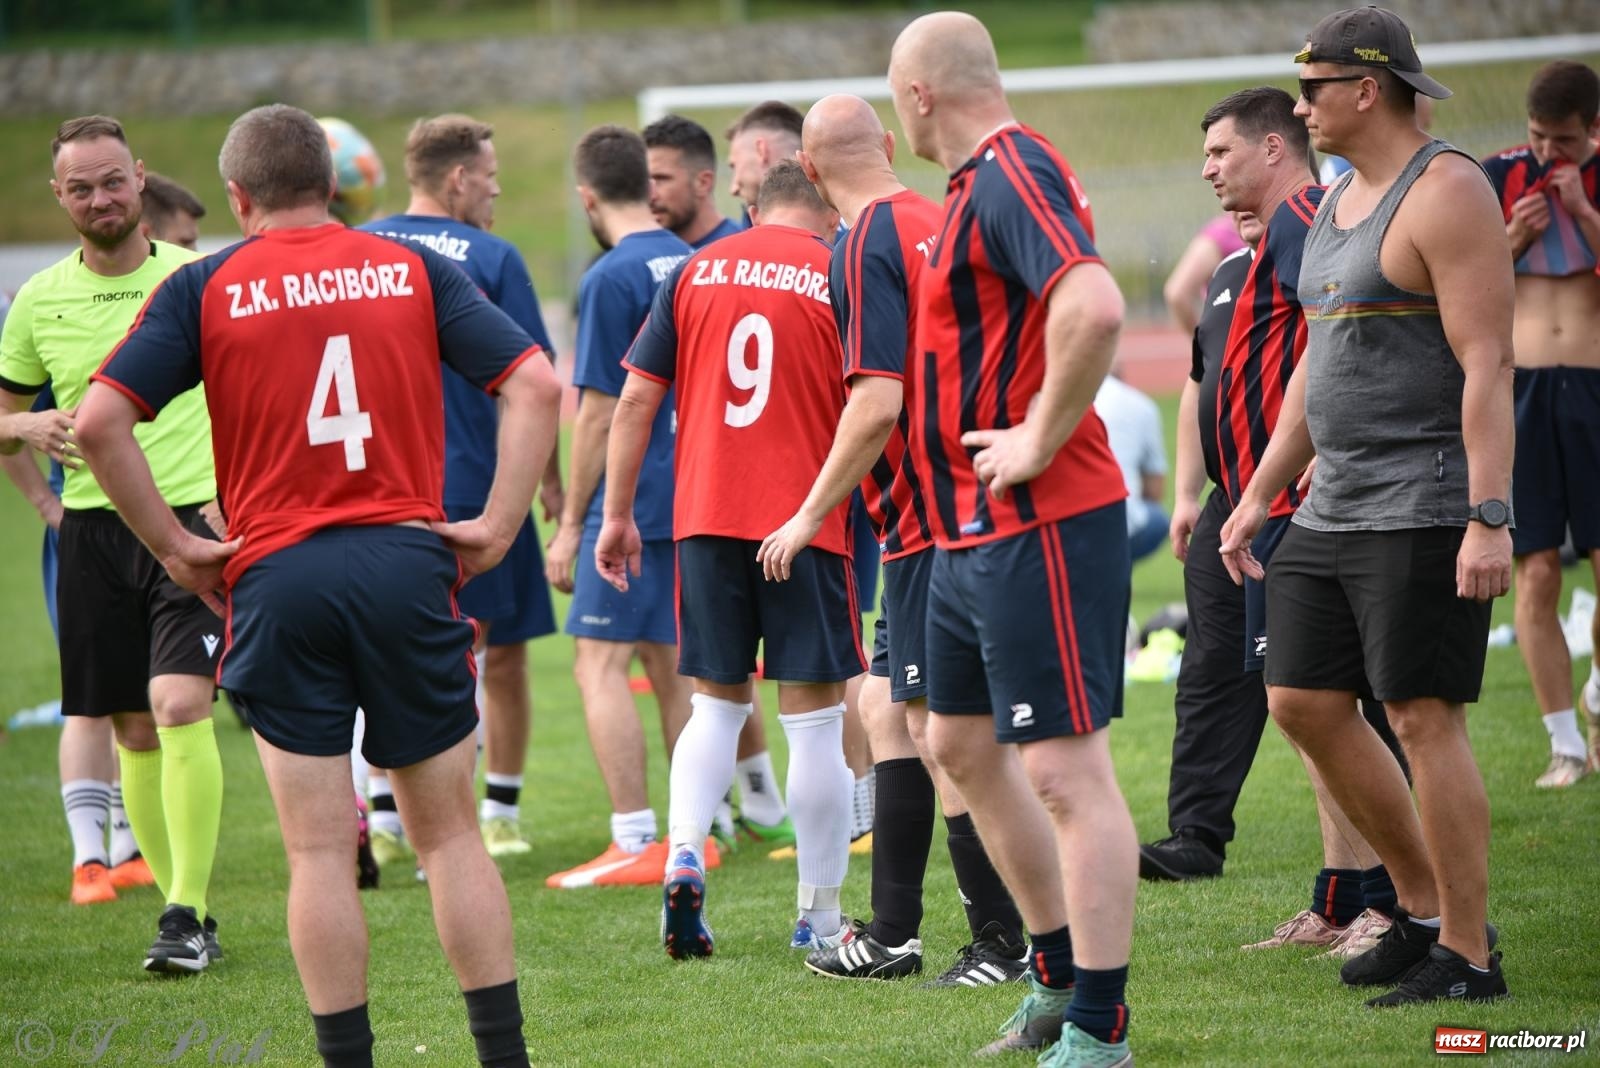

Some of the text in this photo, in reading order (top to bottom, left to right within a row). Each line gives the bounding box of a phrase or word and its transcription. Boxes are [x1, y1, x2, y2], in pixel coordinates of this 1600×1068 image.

[93, 290, 143, 303] macron
[225, 259, 414, 319] Z.K. RACIBÓRZ
[692, 258, 729, 286] Z.K.
[724, 313, 774, 428] 9
[306, 333, 373, 472] 4
